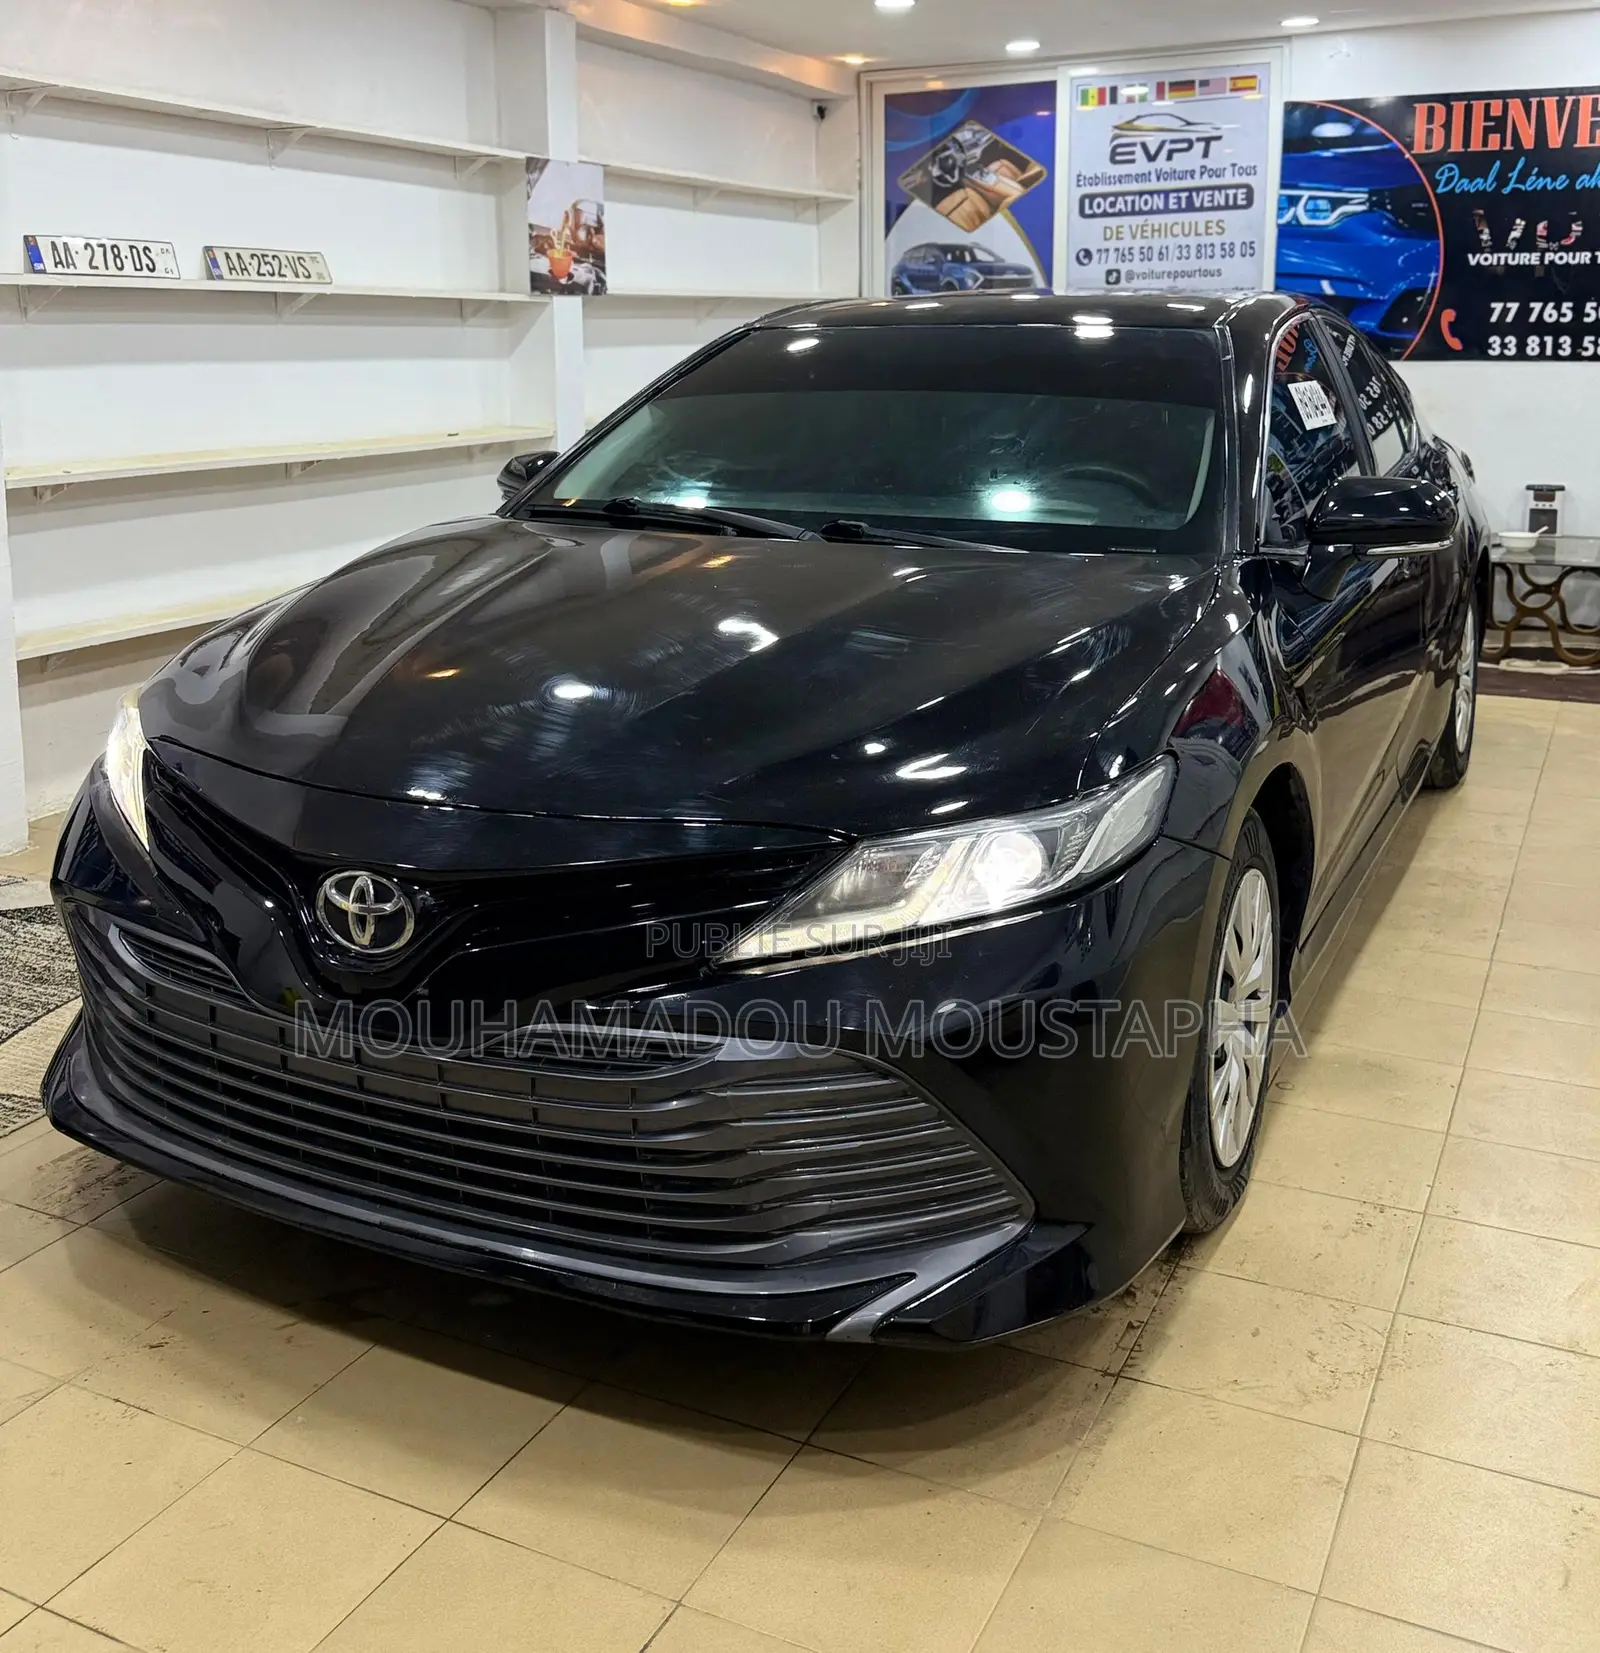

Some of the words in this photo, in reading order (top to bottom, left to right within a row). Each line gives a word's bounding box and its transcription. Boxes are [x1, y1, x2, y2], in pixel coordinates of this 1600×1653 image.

[1109, 135, 1223, 165] EVPT
[1076, 168, 1152, 188] Établissement
[1155, 168, 1196, 183] Voiture
[1199, 165, 1227, 180] Pour
[1230, 163, 1257, 178] Tous
[1435, 160, 1500, 194] Daal
[1501, 156, 1570, 195] Léne
[1084, 193, 1165, 214] LOCATION
[1168, 192, 1189, 209] ET
[1193, 188, 1248, 208] VENTE
[1103, 225, 1125, 241] DE
[1129, 219, 1226, 240] VÉHICULES
[1096, 248, 1110, 264] 77
[1114, 247, 1135, 263] 765
[1139, 246, 1153, 262] 50
[1196, 243, 1216, 259] 813
[1220, 242, 1235, 259] 58
[1240, 241, 1256, 258] 05
[1468, 253, 1540, 266] VOITURE
[1544, 251, 1592, 265] POUR
[1125, 267, 1222, 282] @voiturepourtous
[1489, 302, 1520, 323] 77
[1528, 302, 1574, 323] 765
[1583, 302, 1600, 323] 5
[1487, 335, 1517, 356] 33
[1525, 335, 1572, 356] 813
[1581, 336, 1600, 356] 5
